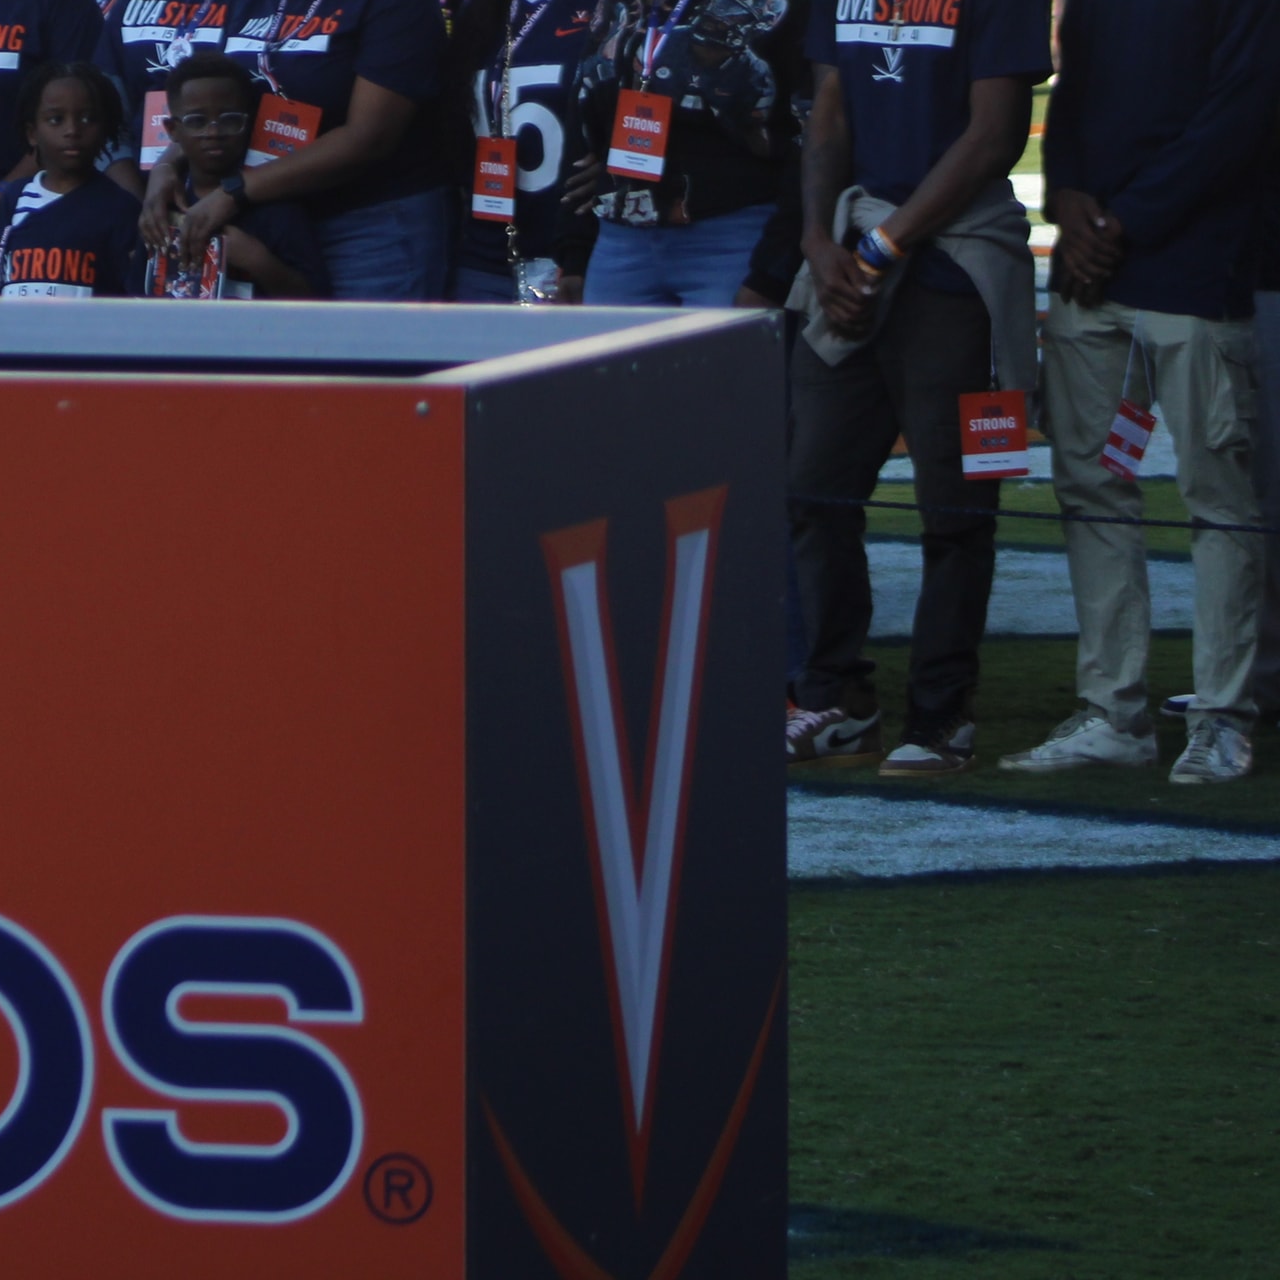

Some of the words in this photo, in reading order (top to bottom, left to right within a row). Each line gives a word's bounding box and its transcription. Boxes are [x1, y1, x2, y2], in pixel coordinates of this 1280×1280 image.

[264, 120, 308, 141] STRONG
[623, 116, 662, 133] STRONG
[479, 161, 510, 176] STRONG
[969, 416, 1017, 432] STRONG
